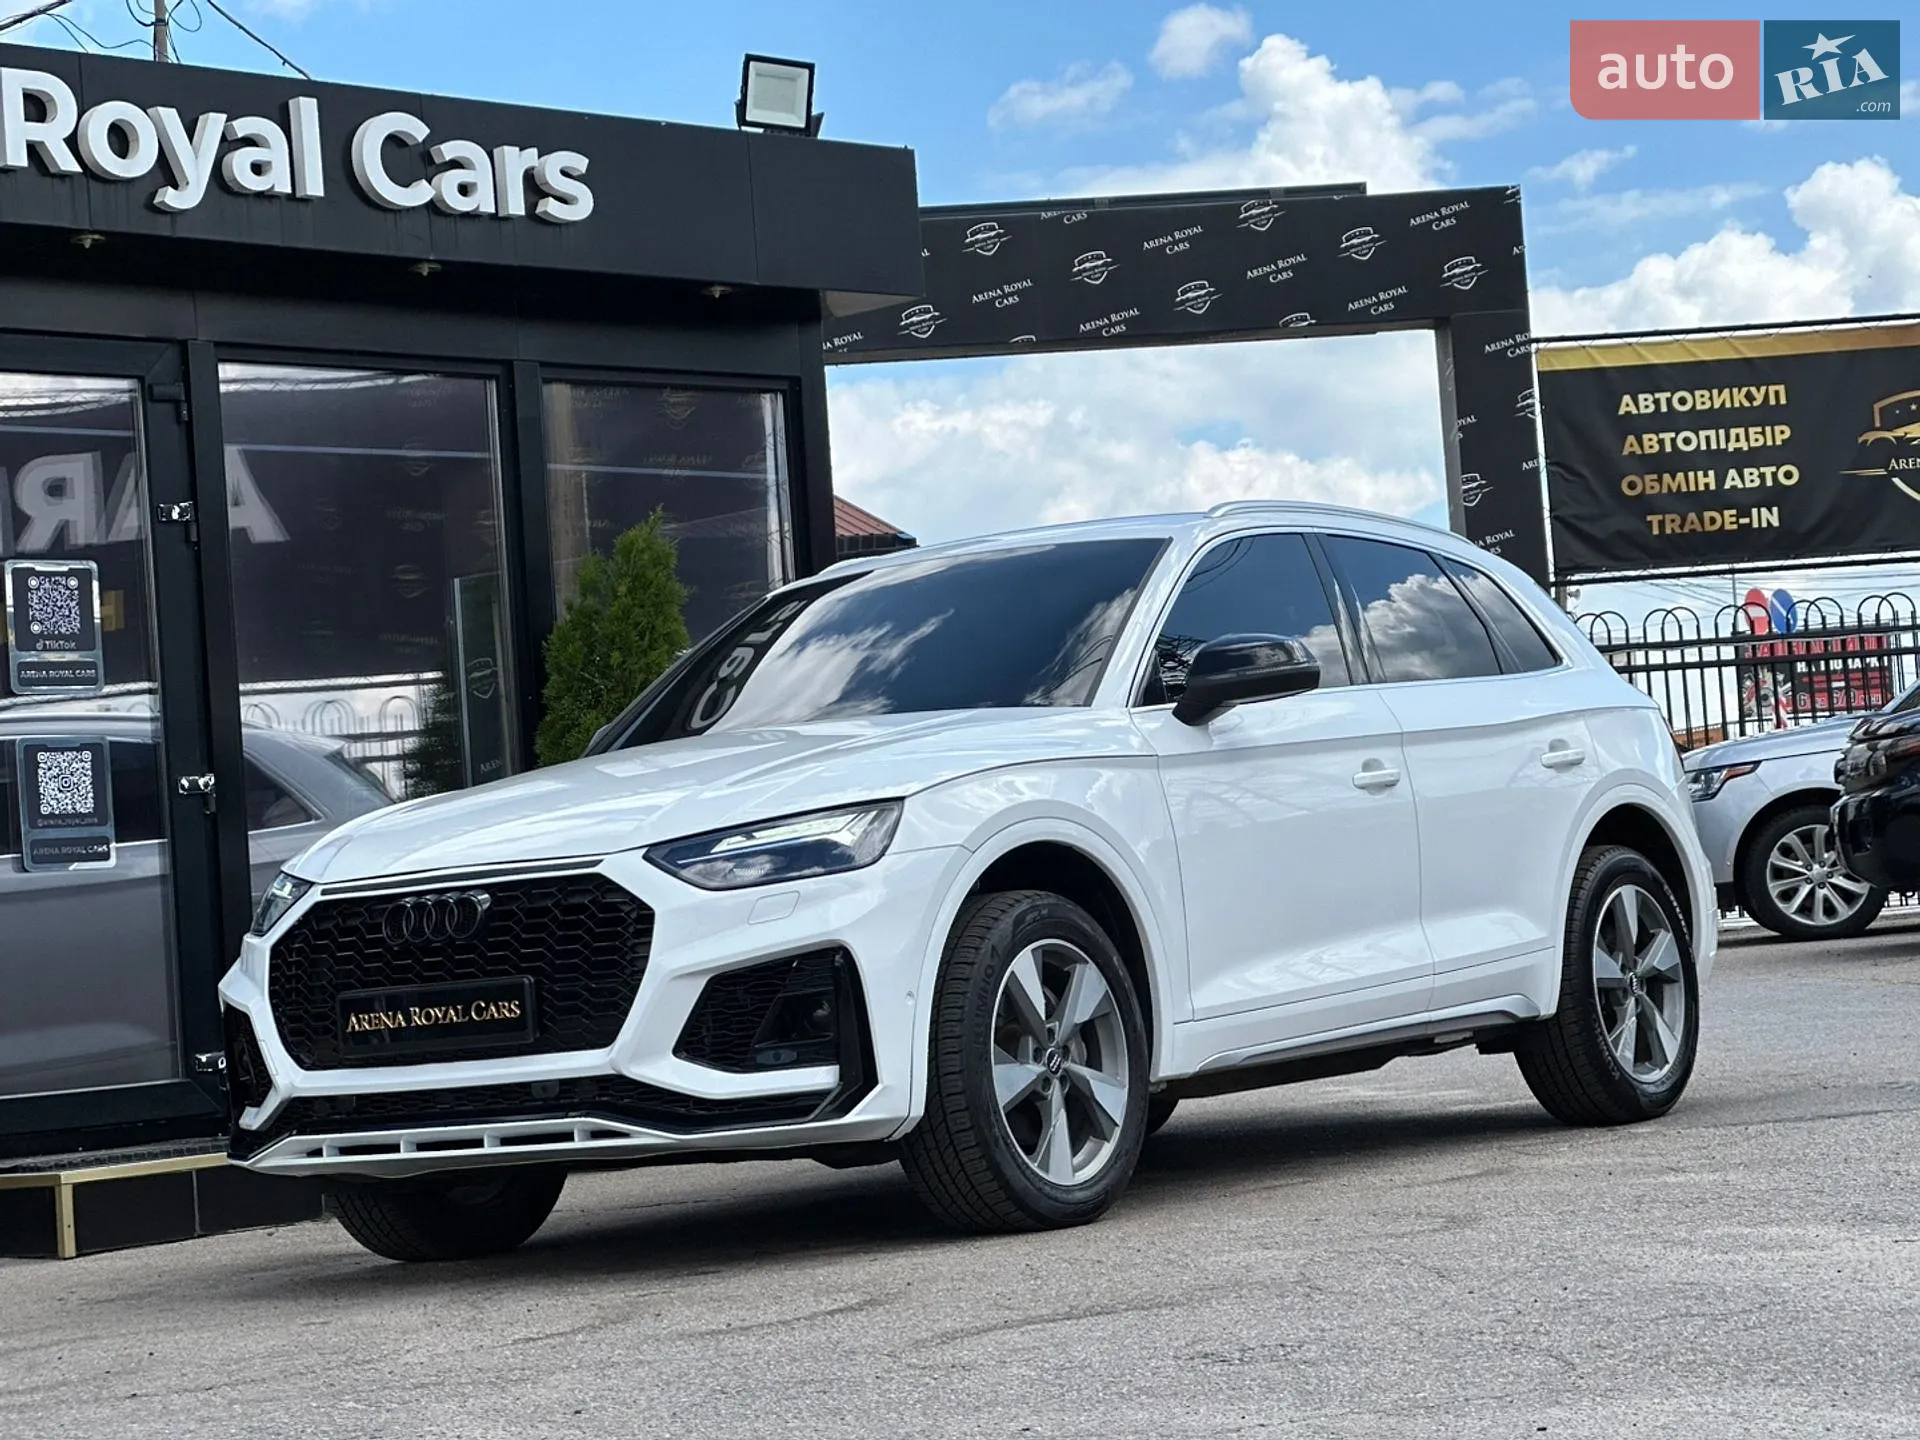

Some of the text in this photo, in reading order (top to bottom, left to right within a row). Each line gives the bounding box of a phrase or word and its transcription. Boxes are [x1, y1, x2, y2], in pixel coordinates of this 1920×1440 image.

[0, 66, 595, 224] Royal Cars
[1618, 384, 1787, 416] АВТОВИКУП
[1622, 424, 1792, 456] АВТОПІДБІР
[1621, 464, 1800, 498] ОБМІН АВТО
[1646, 506, 1781, 537] TRADE-IN
[346, 999, 522, 1033] ARENA ROYAL CARS
